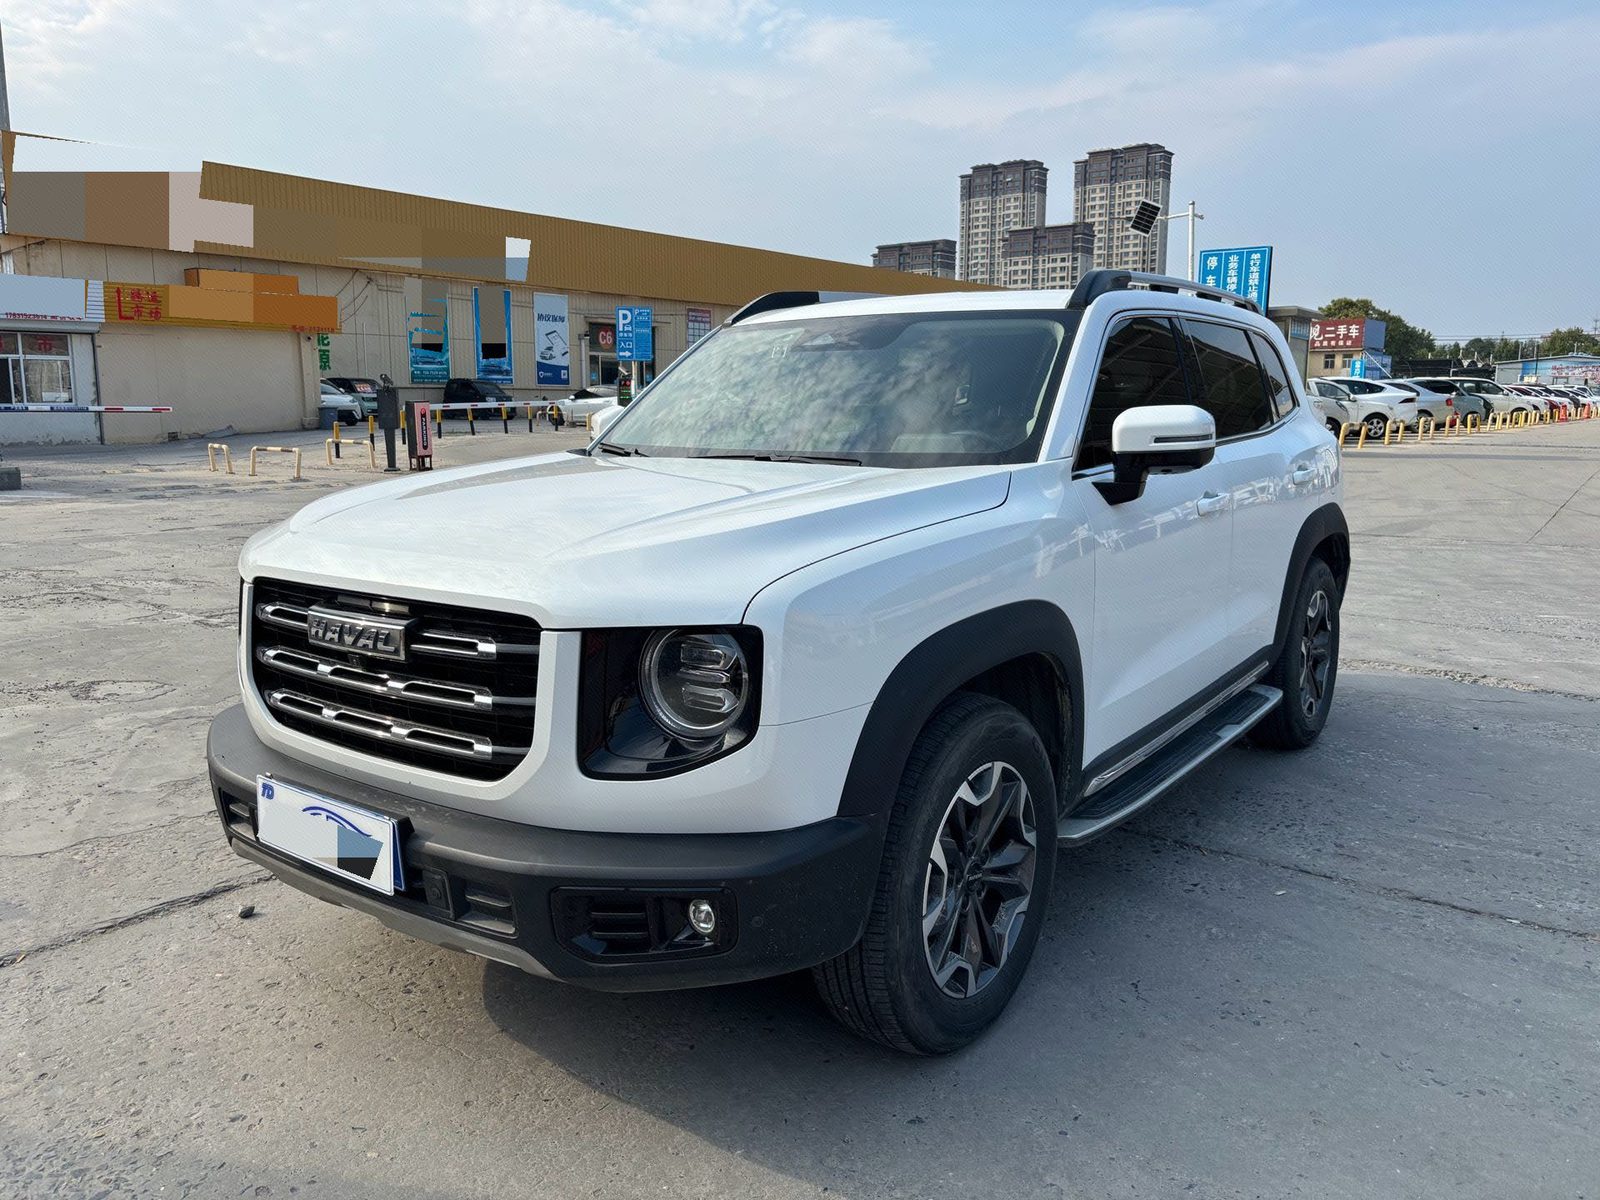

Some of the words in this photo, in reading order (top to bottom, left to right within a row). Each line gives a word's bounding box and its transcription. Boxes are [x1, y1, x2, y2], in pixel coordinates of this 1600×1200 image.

[1226, 254, 1240, 294] 业务车辆停
[618, 309, 632, 332] P
[599, 331, 613, 345] C6
[620, 341, 633, 349] 入口
[311, 619, 396, 652] HAVAL
